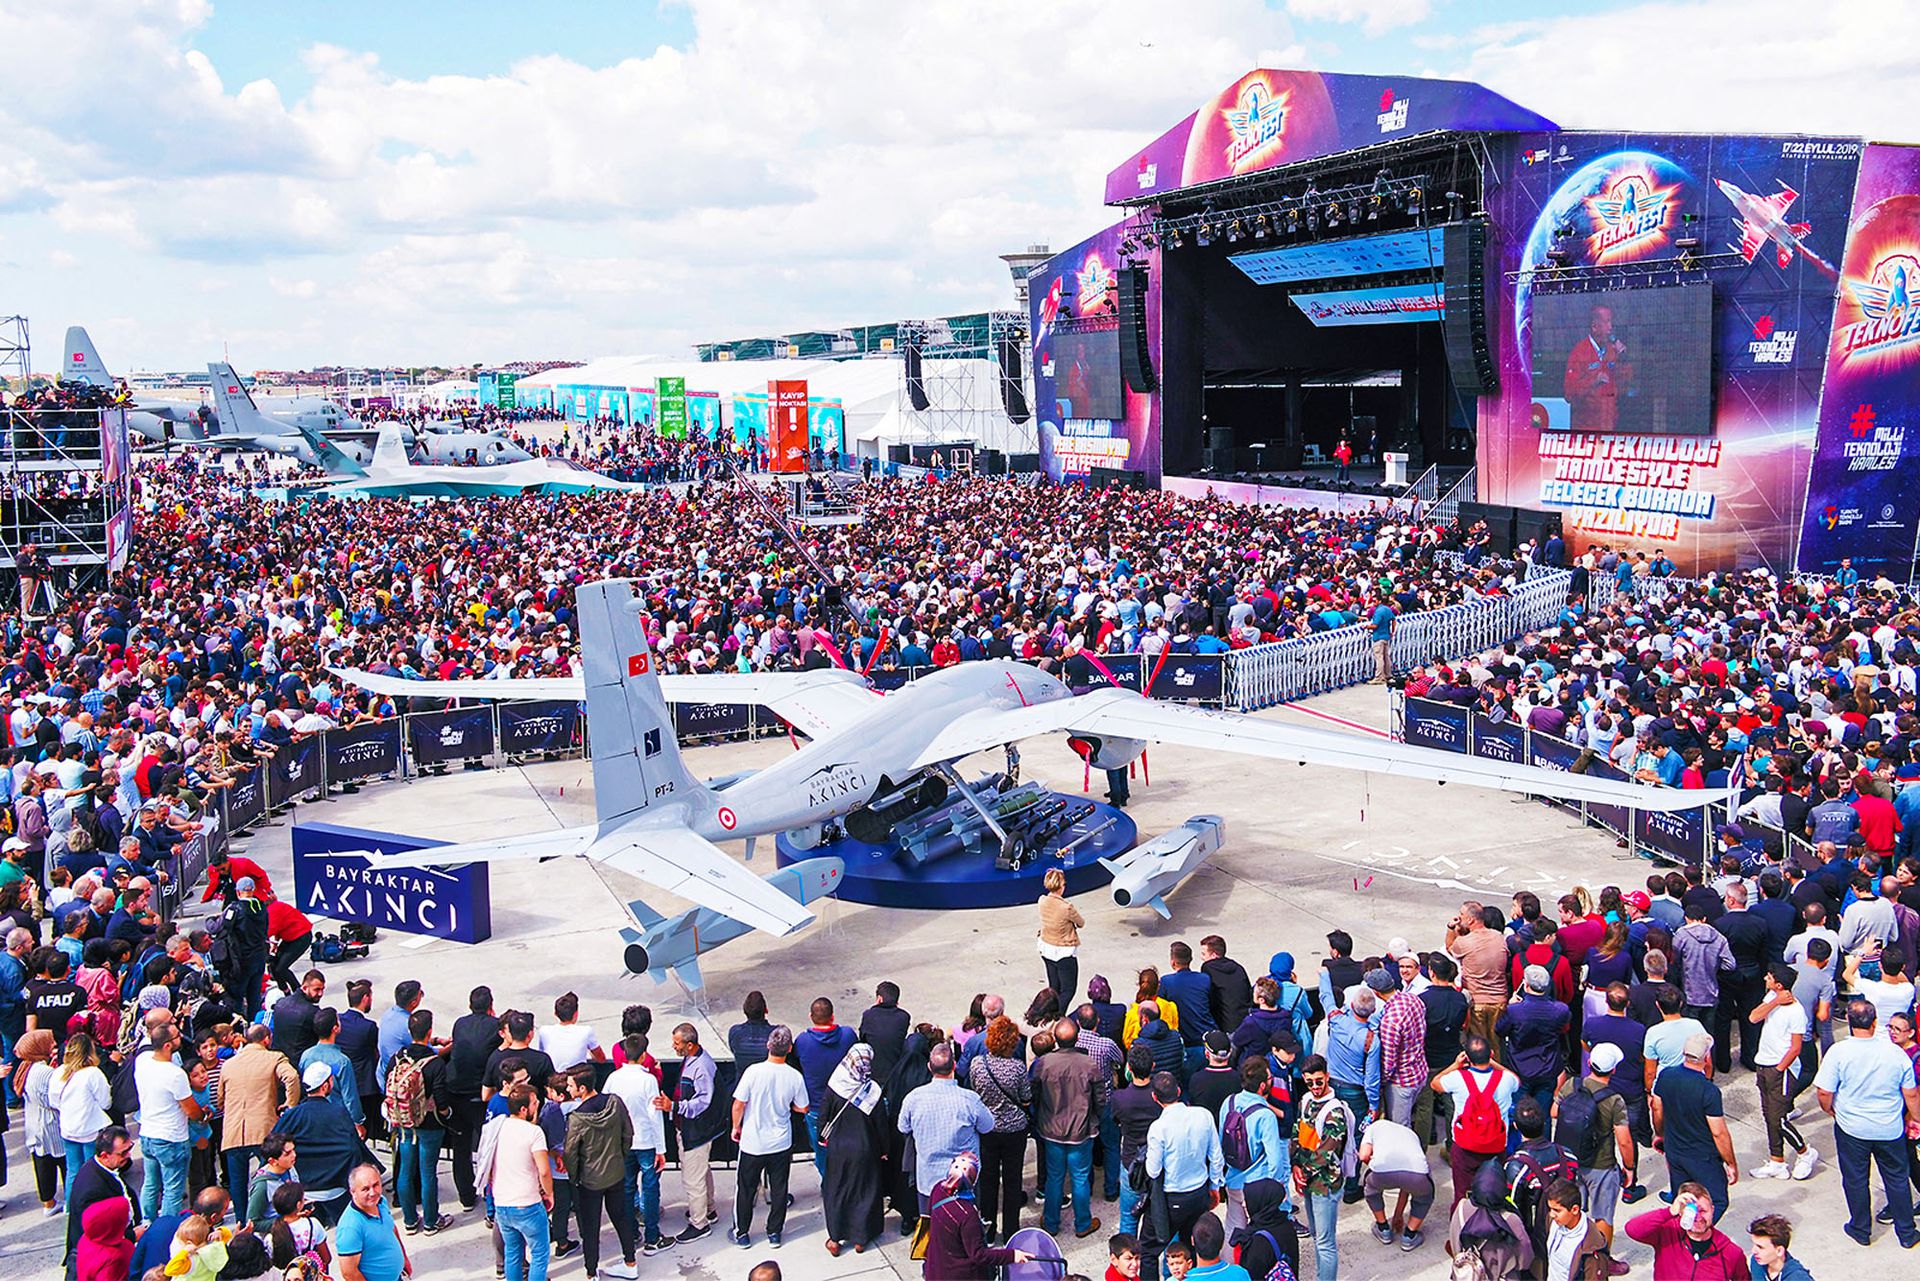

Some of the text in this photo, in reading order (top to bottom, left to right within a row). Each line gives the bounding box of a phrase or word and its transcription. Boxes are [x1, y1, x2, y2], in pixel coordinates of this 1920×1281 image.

[1231, 110, 1284, 163] TEKNOFEST
[1836, 144, 1859, 155] 2019
[1598, 204, 1668, 251] TEKNOFEST
[1540, 480, 1716, 520] GELECEK BURADA
[1570, 507, 1680, 541] YAZILIYOR
[1088, 672, 1135, 684] BAYAR
[690, 708, 734, 720] AKINCI
[514, 723, 563, 737] AKINCI
[1416, 726, 1456, 742] AKINCI
[339, 749, 385, 764] AKINCI
[1481, 744, 1515, 762] AKINCI
[655, 781, 674, 798] PT-2
[809, 774, 867, 808] AKINCI
[325, 864, 436, 896] BAYRAKTAR
[309, 880, 457, 932] AKINCI
[36, 993, 73, 1008] AFAD
